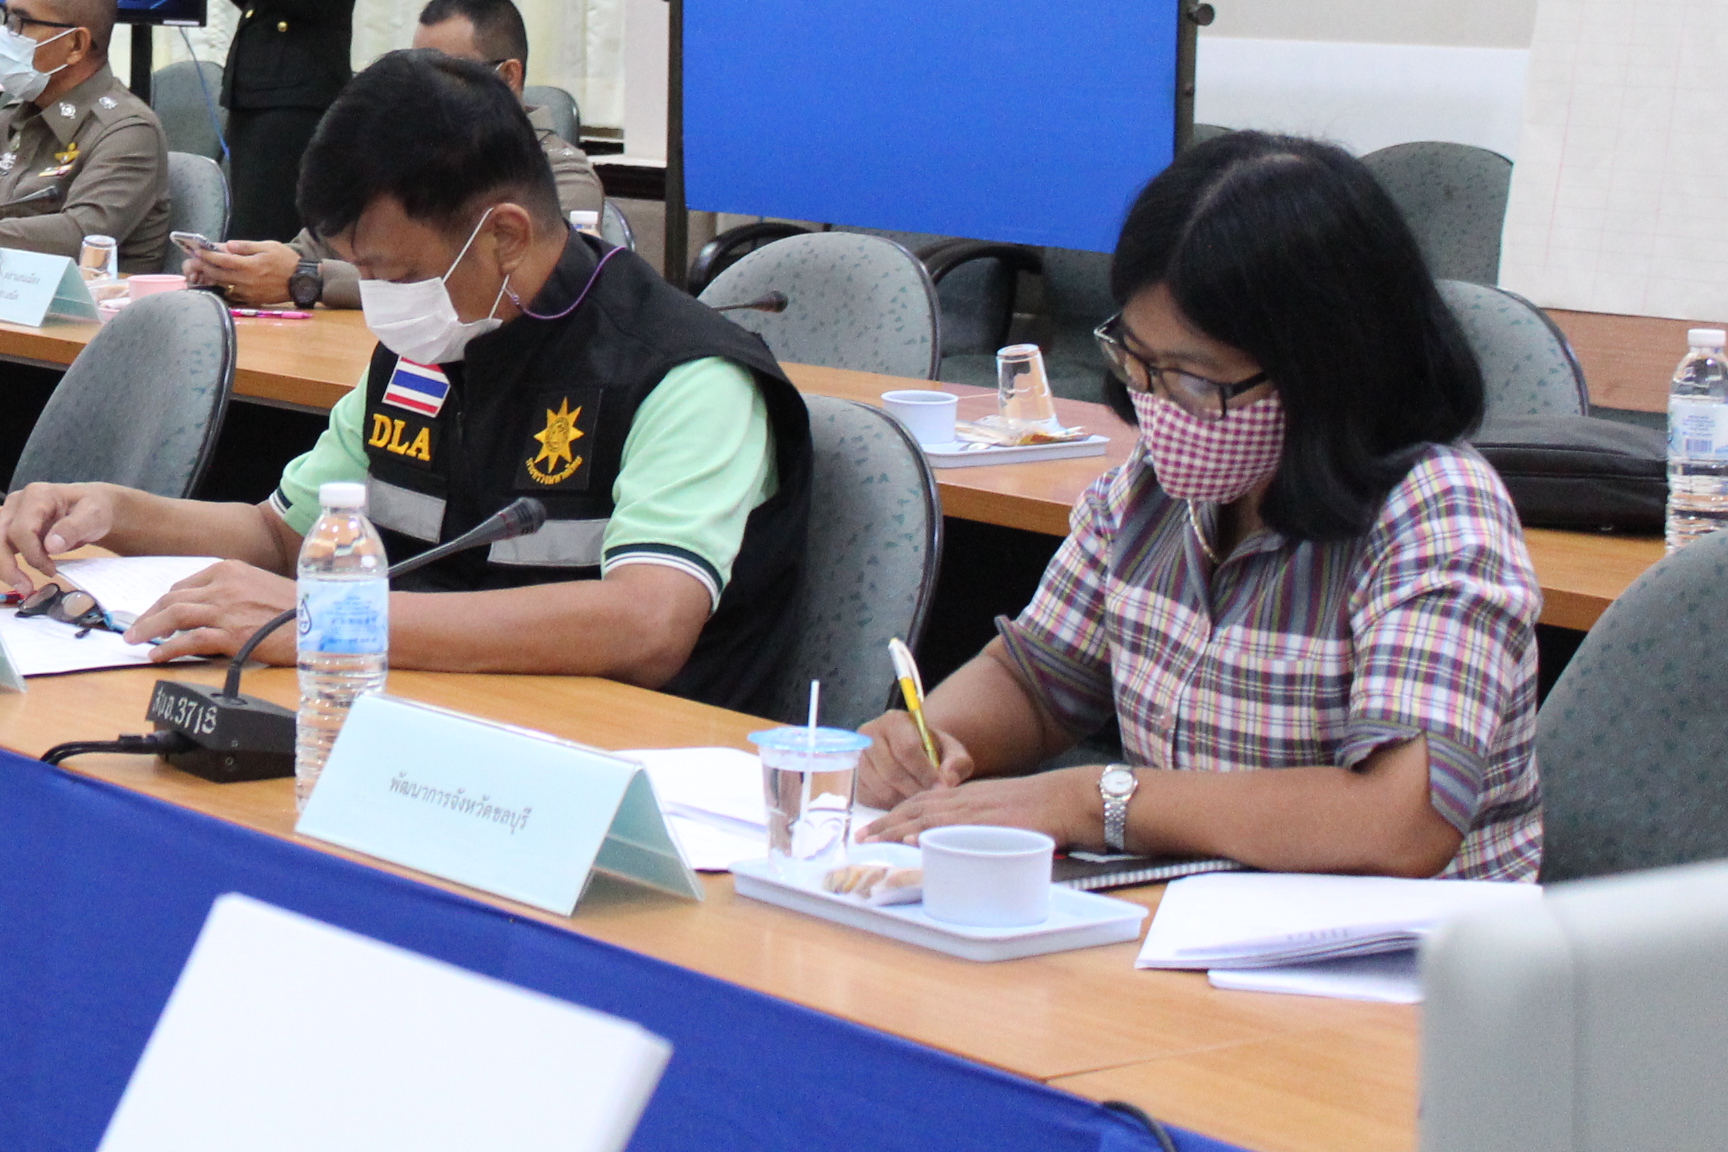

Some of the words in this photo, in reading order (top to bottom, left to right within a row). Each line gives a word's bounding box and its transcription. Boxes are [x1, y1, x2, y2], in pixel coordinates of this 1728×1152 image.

[368, 413, 432, 462] DLA
[389, 771, 532, 835] พัฒนาการจังหวัดชลบุรี
